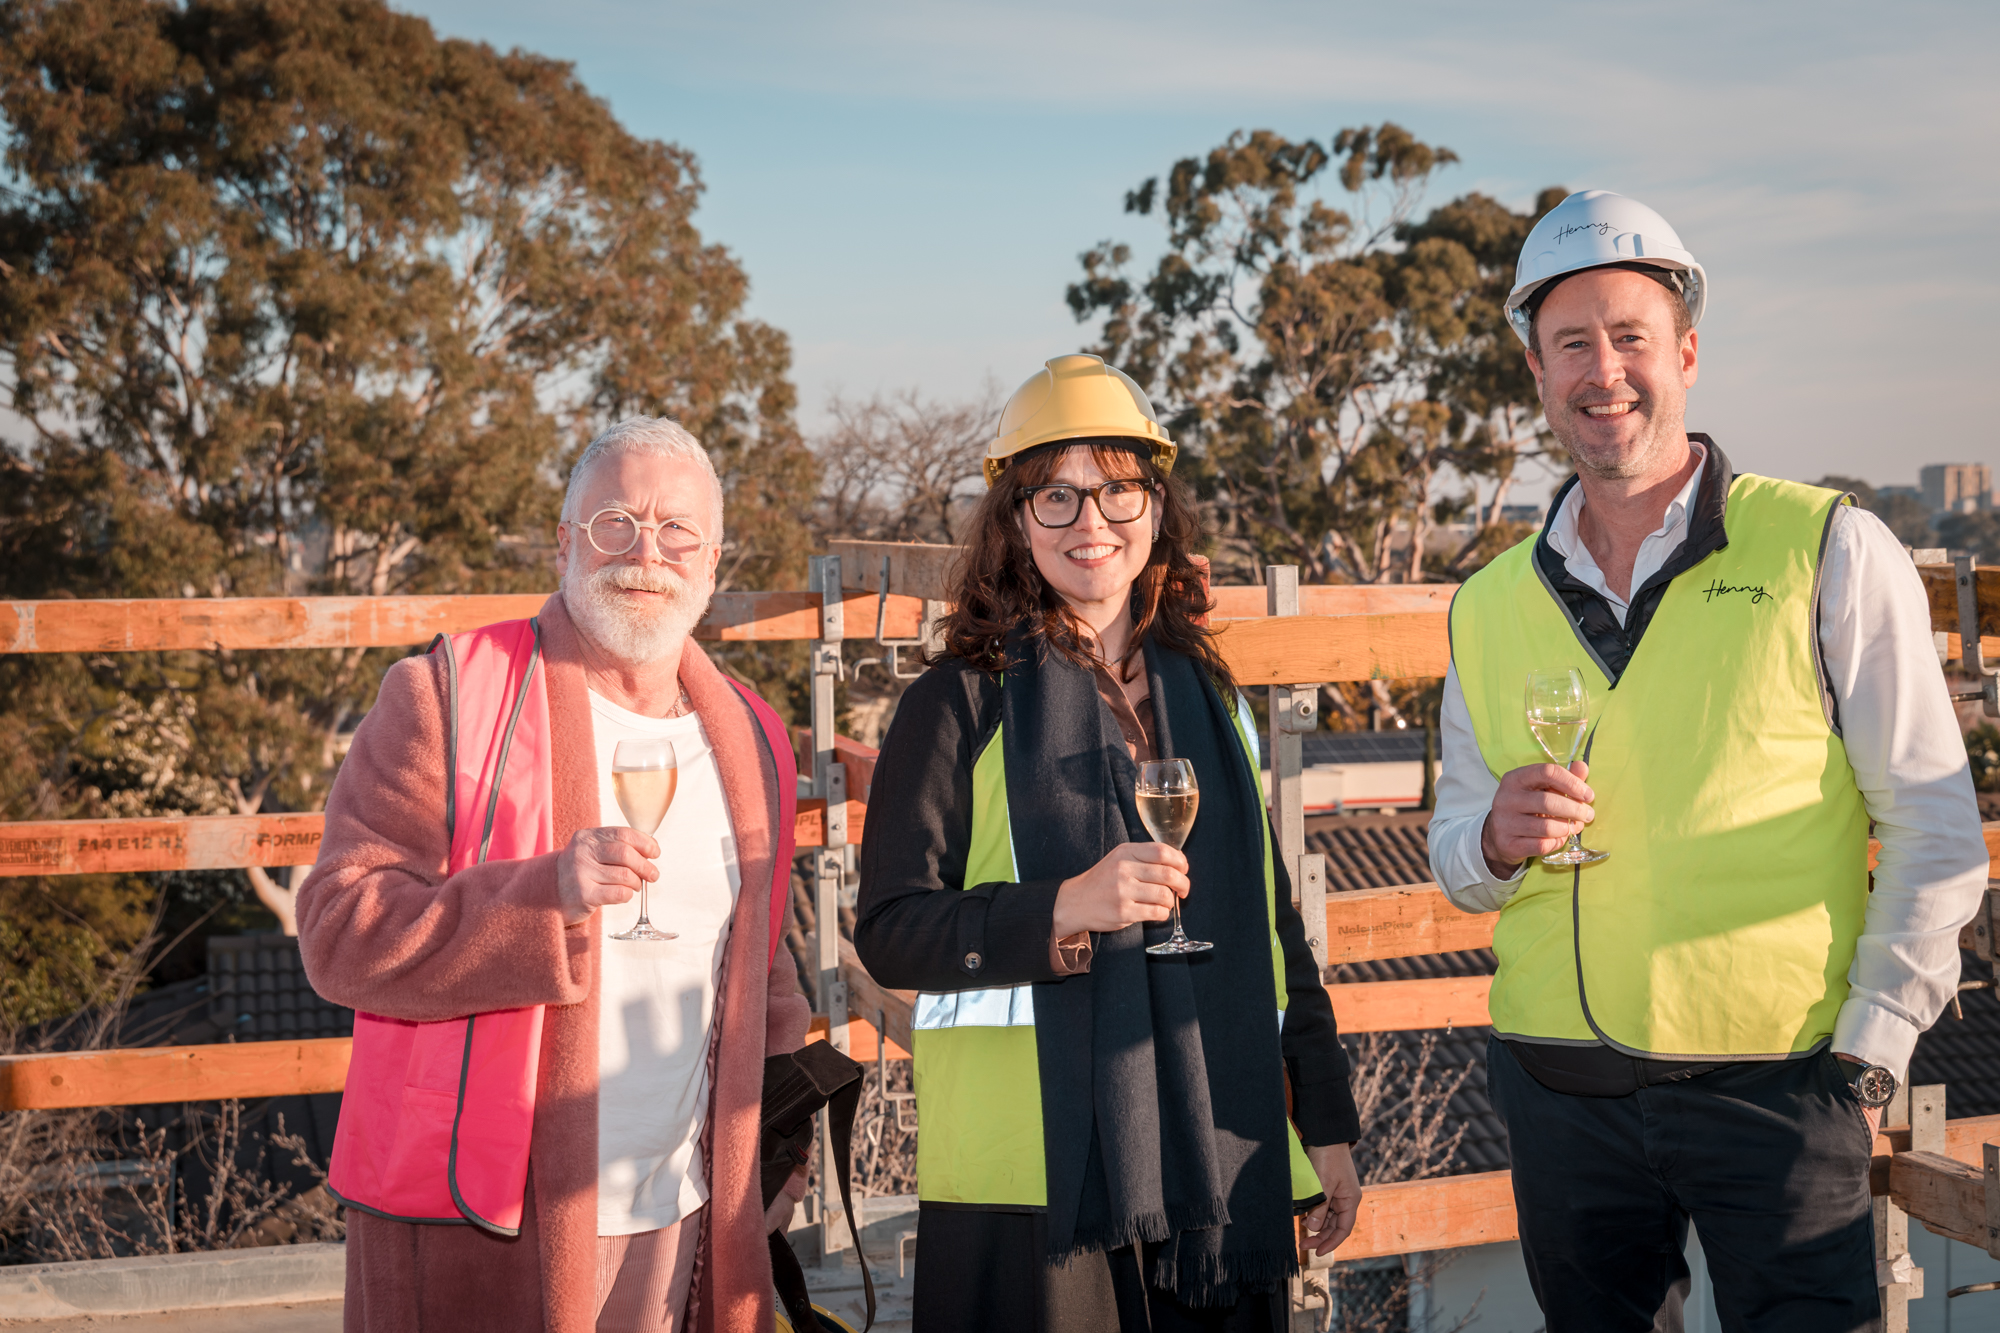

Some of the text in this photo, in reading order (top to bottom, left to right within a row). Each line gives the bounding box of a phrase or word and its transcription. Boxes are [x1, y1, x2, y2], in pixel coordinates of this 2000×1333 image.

[1553, 222, 1619, 245] Henny
[1702, 579, 1774, 604] Henny
[78, 838, 112, 851] F14
[118, 837, 152, 850] E12
